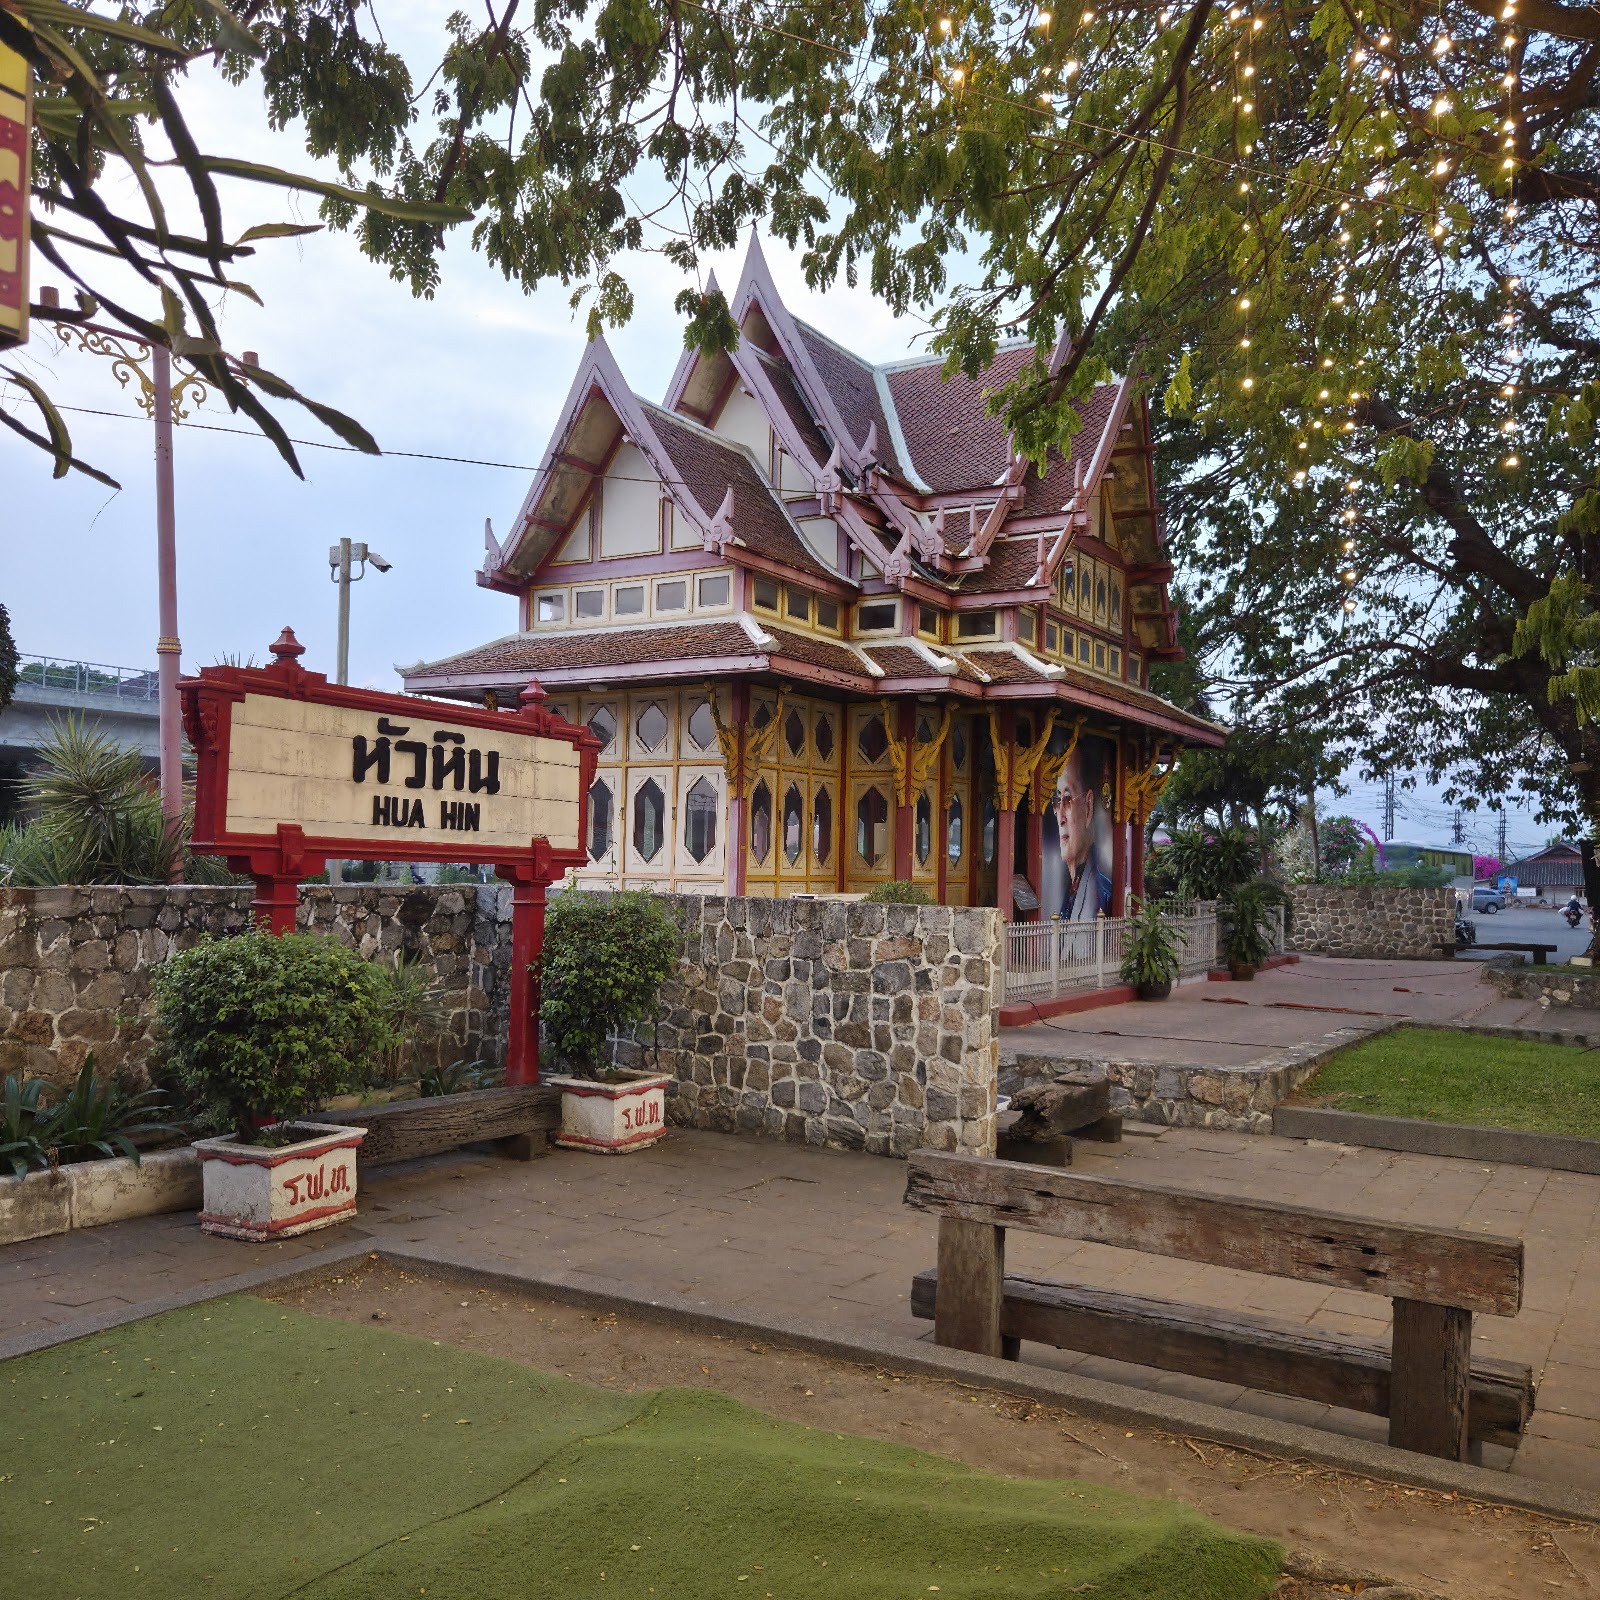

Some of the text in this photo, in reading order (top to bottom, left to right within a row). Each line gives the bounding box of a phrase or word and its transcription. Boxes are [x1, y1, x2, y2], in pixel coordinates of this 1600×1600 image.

[353, 717, 500, 794] หัวหิน
[373, 795, 480, 831] HUA HIN
